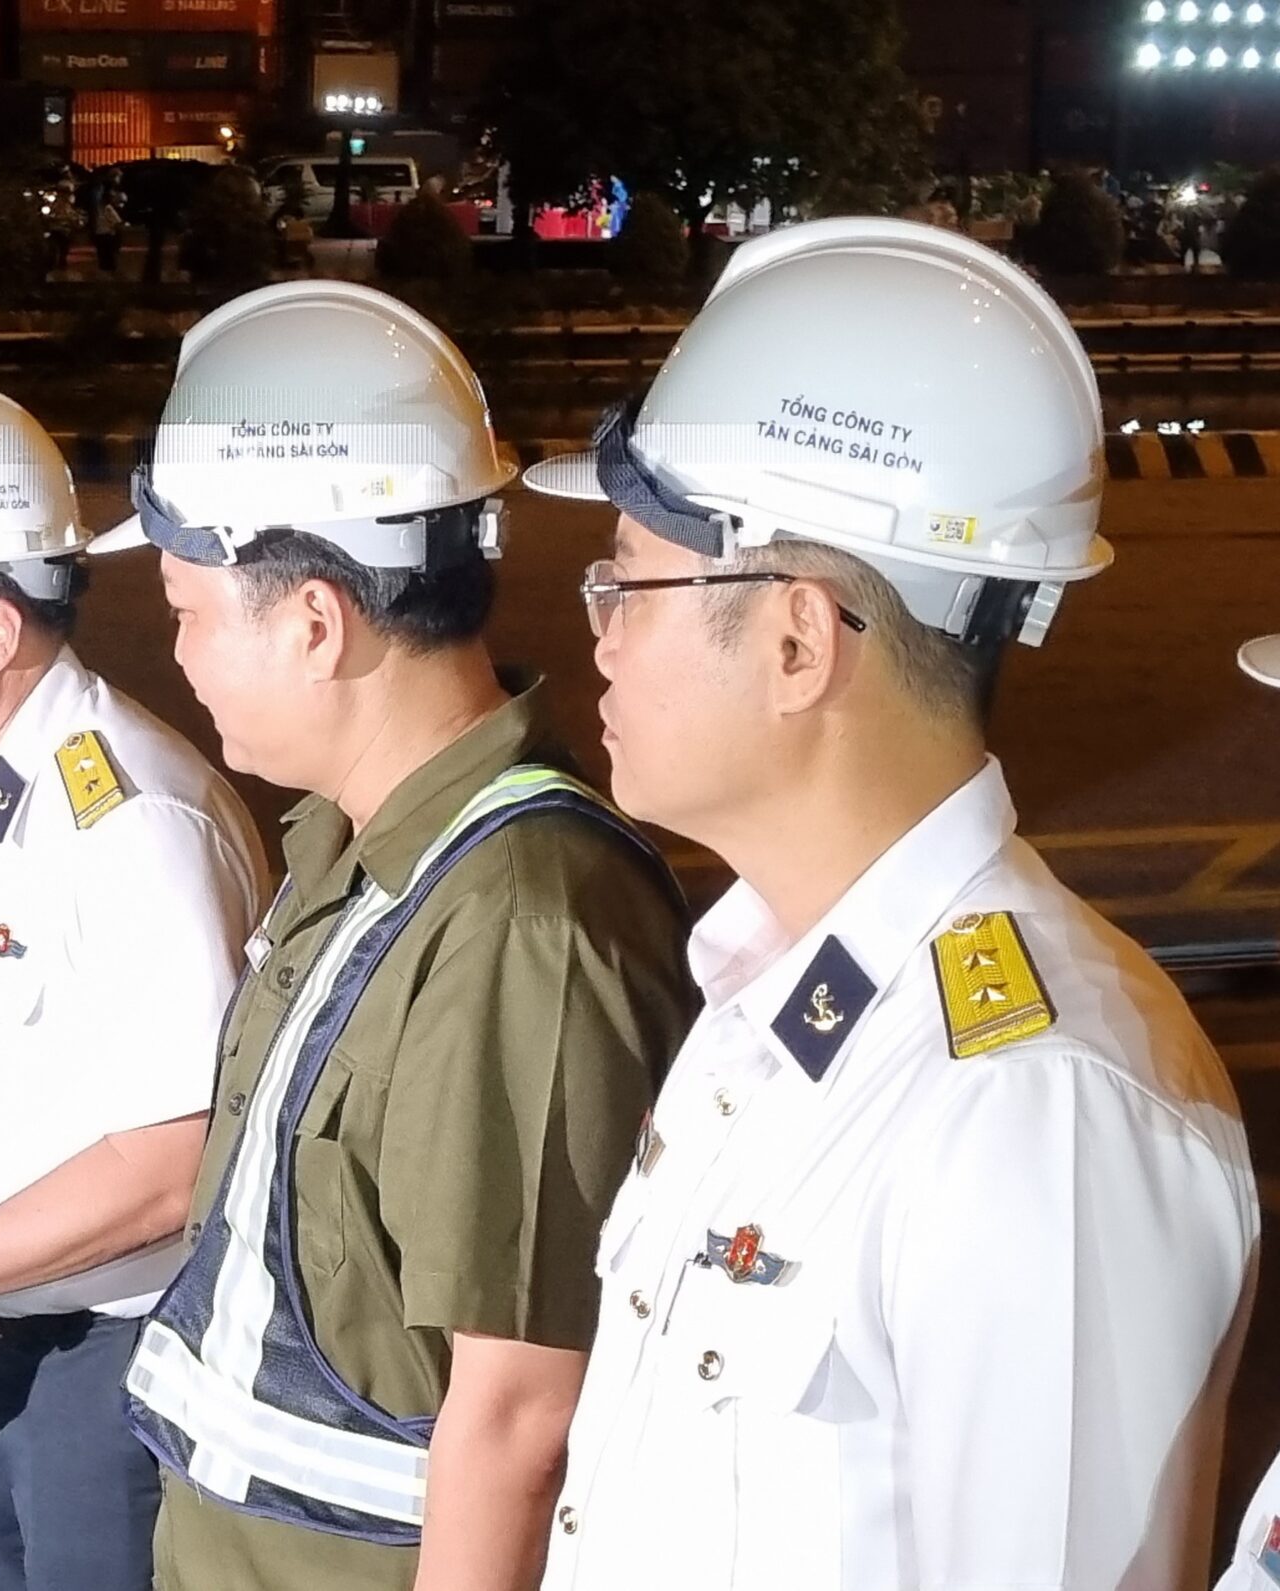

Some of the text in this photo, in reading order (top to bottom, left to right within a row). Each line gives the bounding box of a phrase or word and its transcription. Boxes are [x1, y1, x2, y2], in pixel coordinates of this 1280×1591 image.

[271, 420, 311, 437] CÔNG
[315, 422, 334, 435] TY
[780, 394, 913, 443] TỔNG CÔNG TY
[757, 419, 790, 442] TÂN
